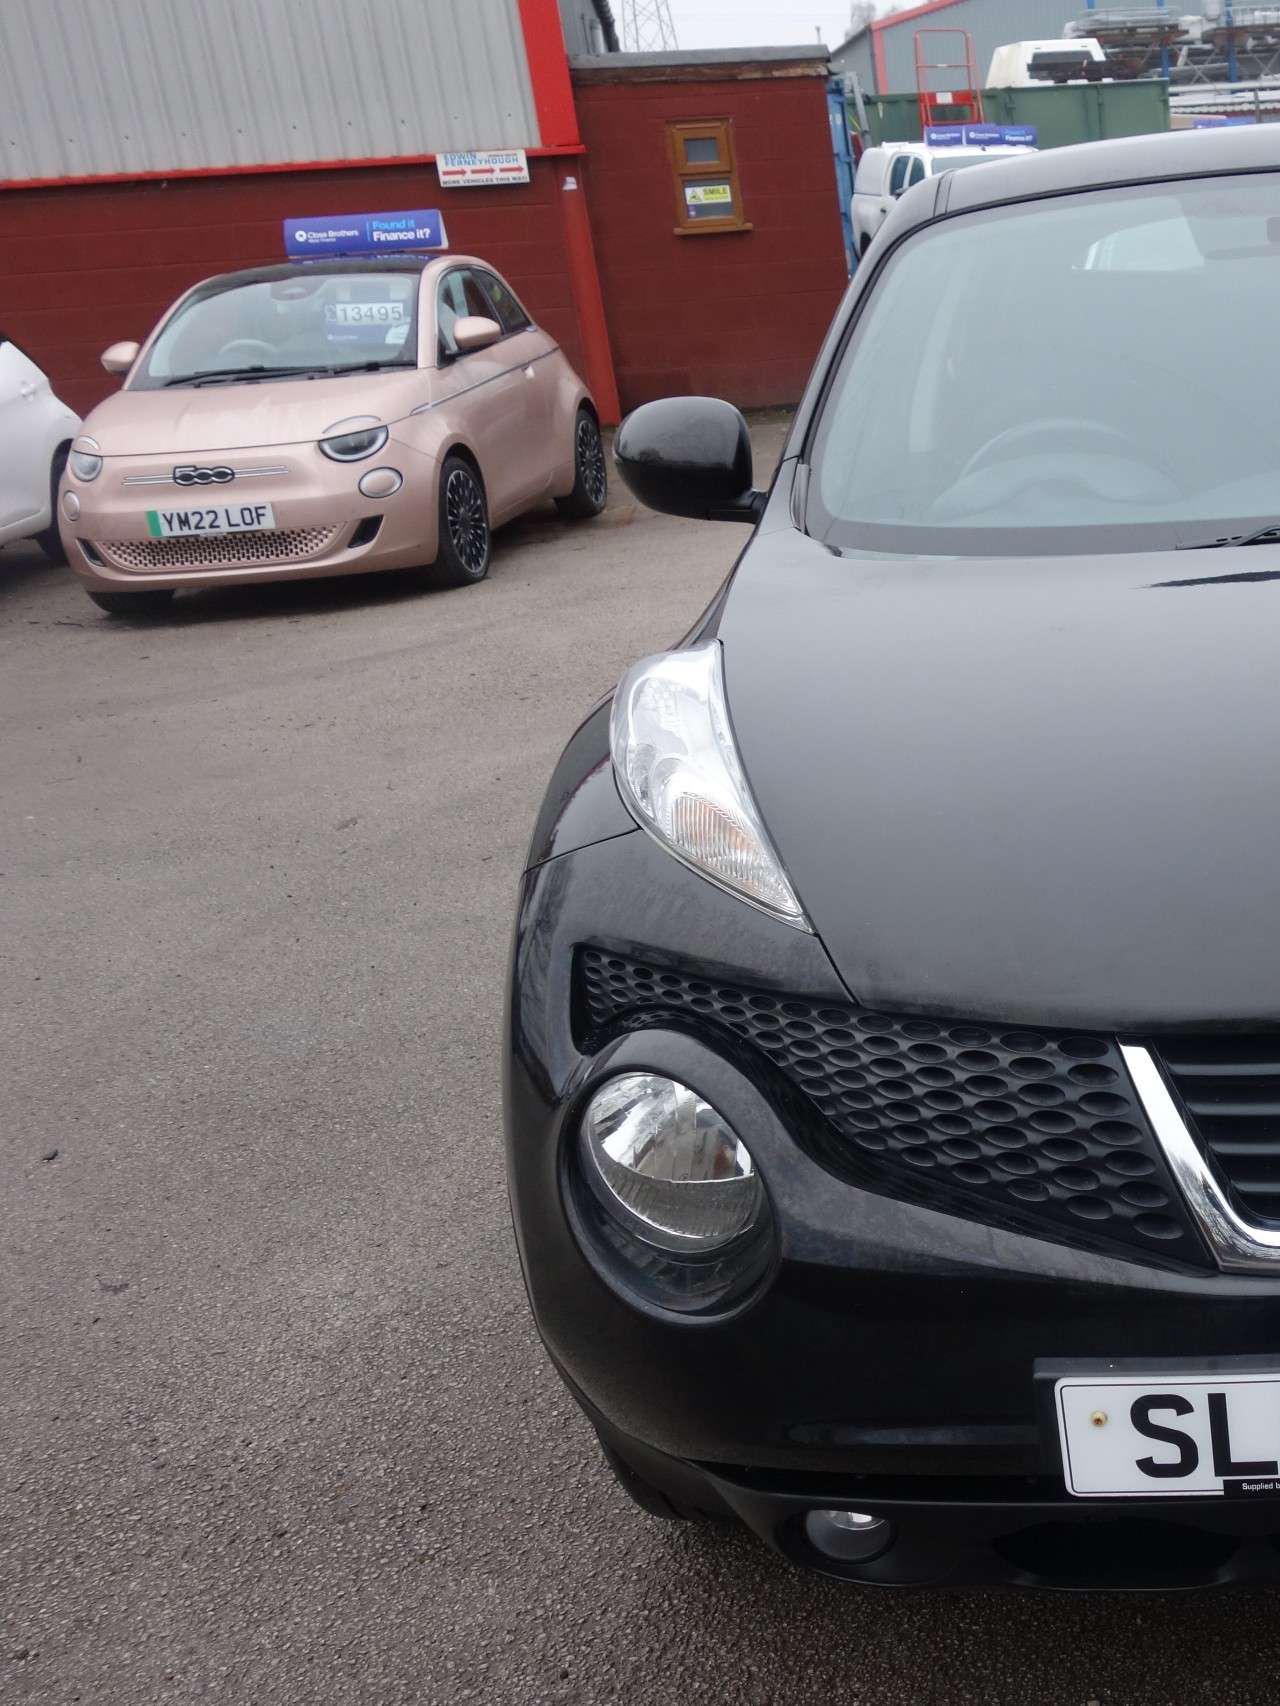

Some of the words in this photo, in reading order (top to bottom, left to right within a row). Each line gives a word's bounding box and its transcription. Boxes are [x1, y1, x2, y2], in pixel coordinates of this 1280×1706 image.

[443, 152, 477, 161] EDWIN
[373, 219, 406, 230] Found
[408, 219, 415, 228] it
[328, 230, 359, 238] Brothers
[373, 230, 414, 241] Finance
[416, 228, 431, 239] it?
[173, 465, 235, 486] 500
[162, 510, 220, 532] YM22
[225, 505, 266, 527] LOF
[1242, 1482, 1274, 1492] Supplied
